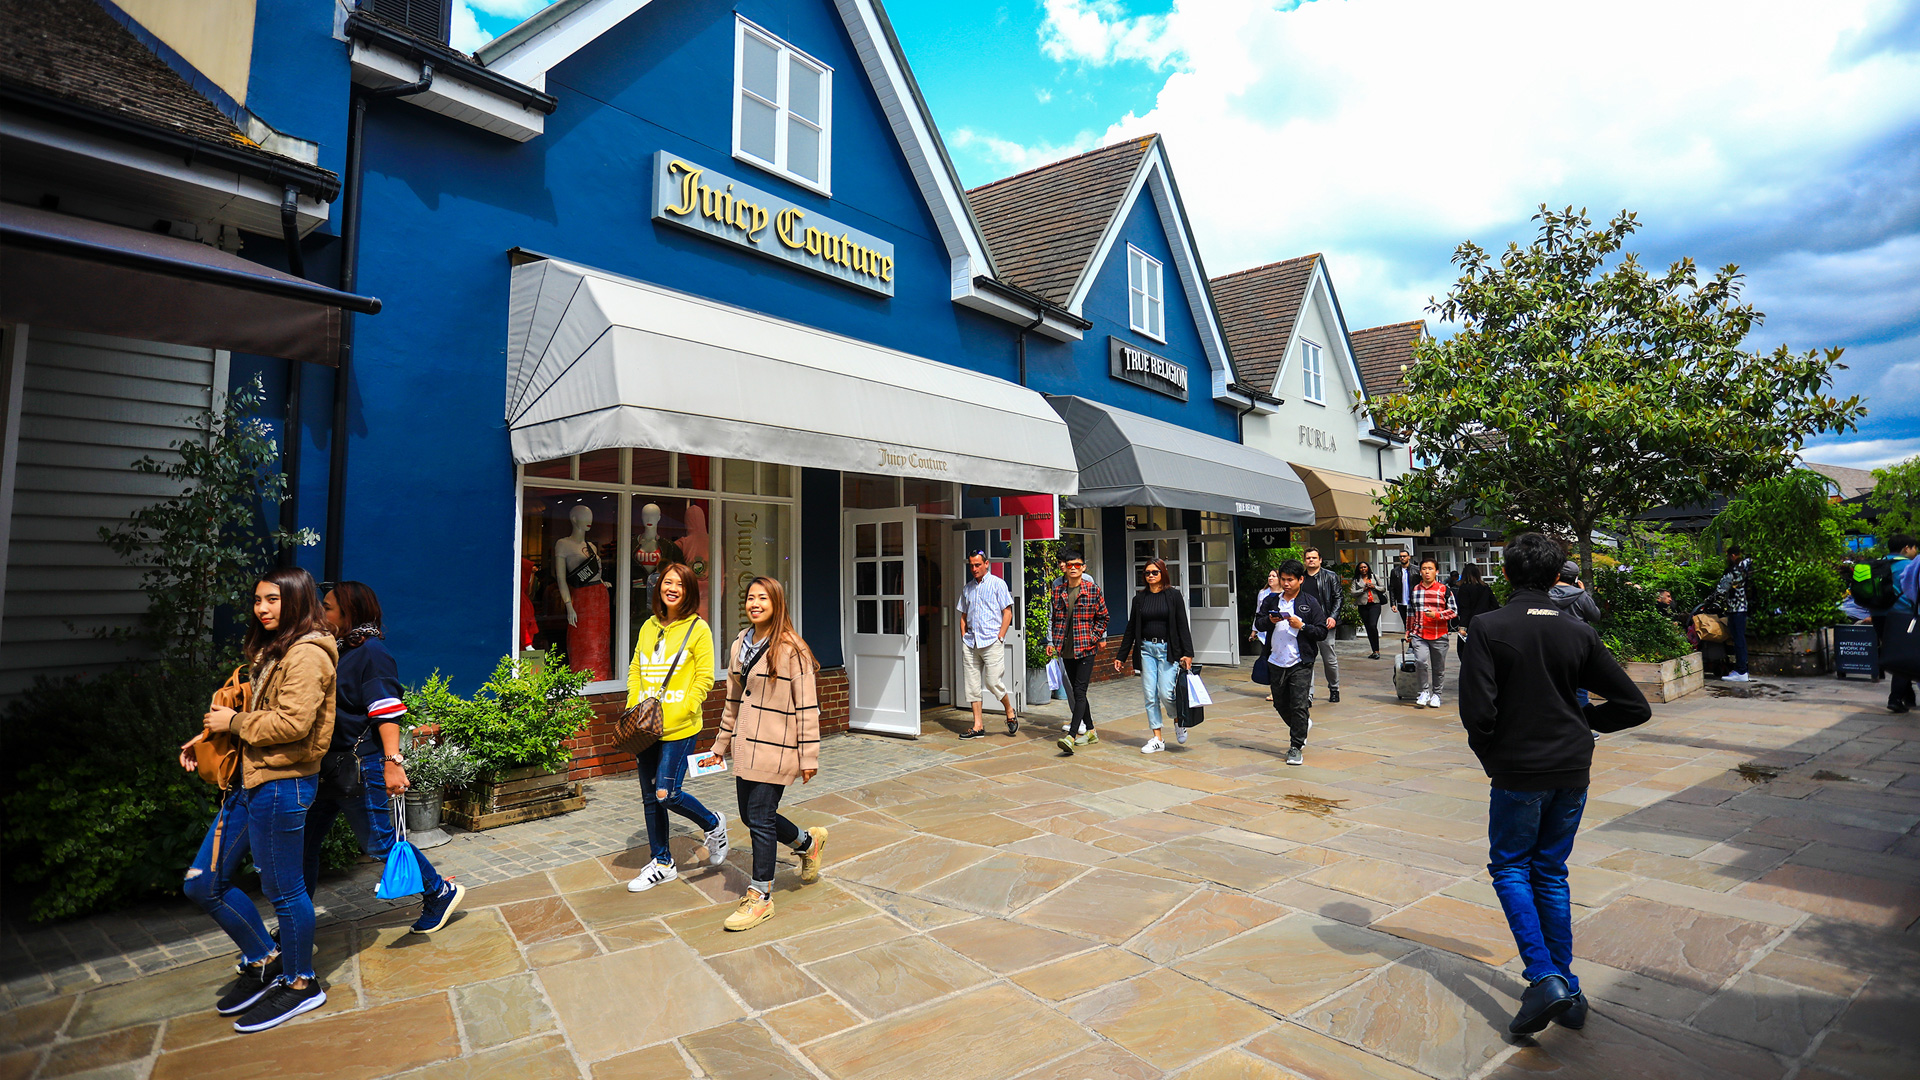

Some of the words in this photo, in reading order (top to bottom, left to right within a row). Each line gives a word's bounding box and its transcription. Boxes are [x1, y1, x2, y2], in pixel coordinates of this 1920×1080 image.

[666, 160, 769, 243] Juicy
[776, 207, 894, 282] Couture
[1124, 347, 1150, 373] TRUE
[1150, 356, 1188, 392] RELIGION
[1298, 424, 1337, 453] FURLA
[878, 448, 907, 467] Juicy
[908, 453, 948, 472] Couture
[1024, 512, 1052, 520] Couture
[638, 686, 685, 703] dias
